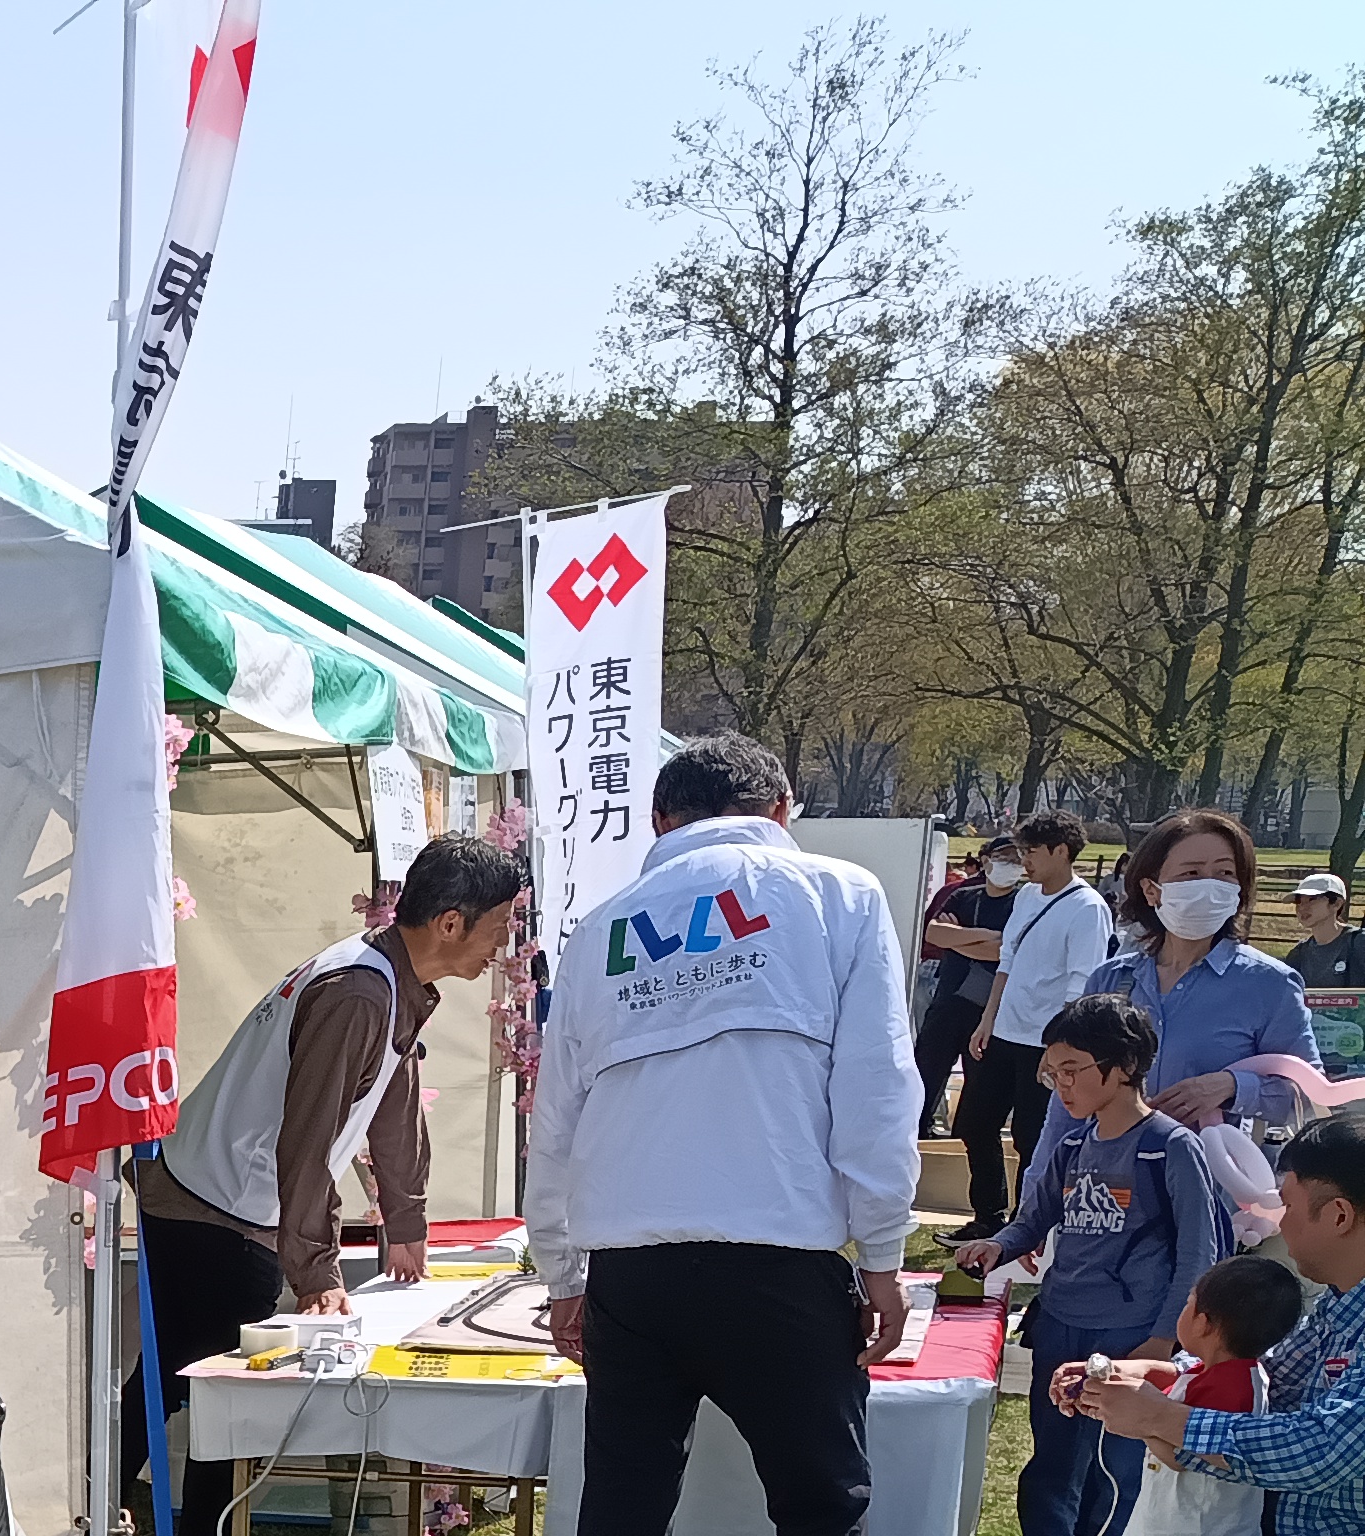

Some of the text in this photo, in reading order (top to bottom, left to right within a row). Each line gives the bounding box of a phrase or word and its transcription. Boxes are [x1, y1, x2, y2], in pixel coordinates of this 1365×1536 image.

[109, 240, 214, 558] 東京
[546, 664, 583, 956] パワーグリッド
[587, 656, 632, 844] 東京電力
[617, 951, 768, 1002] 地域と ともに歩む
